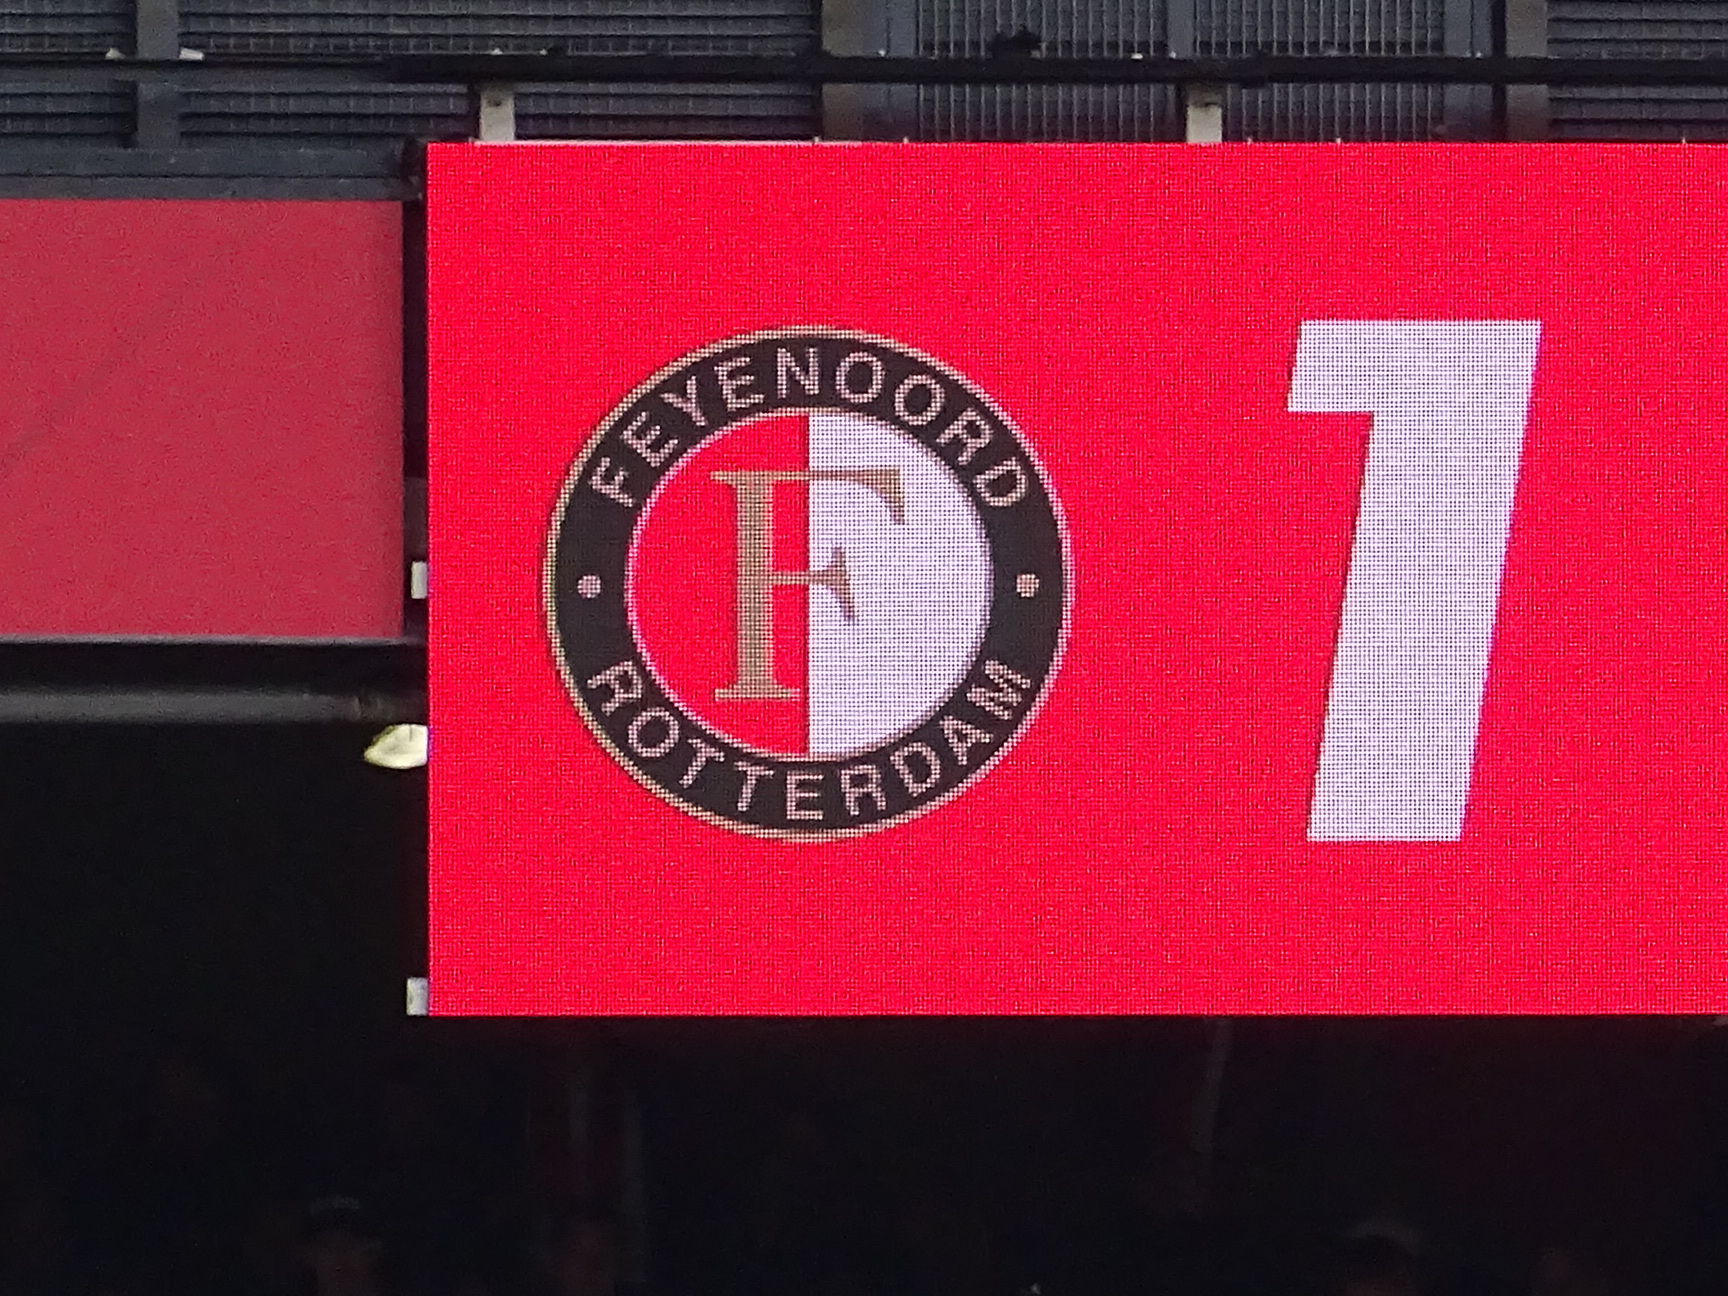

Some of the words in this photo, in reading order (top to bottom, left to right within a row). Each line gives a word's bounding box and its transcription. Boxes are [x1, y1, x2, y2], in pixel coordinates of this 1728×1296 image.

[589, 347, 1029, 508] FEYENOORD
[709, 468, 905, 702] F
[1288, 319, 1542, 841] 1
[588, 659, 1031, 819] ROTTERDAM
